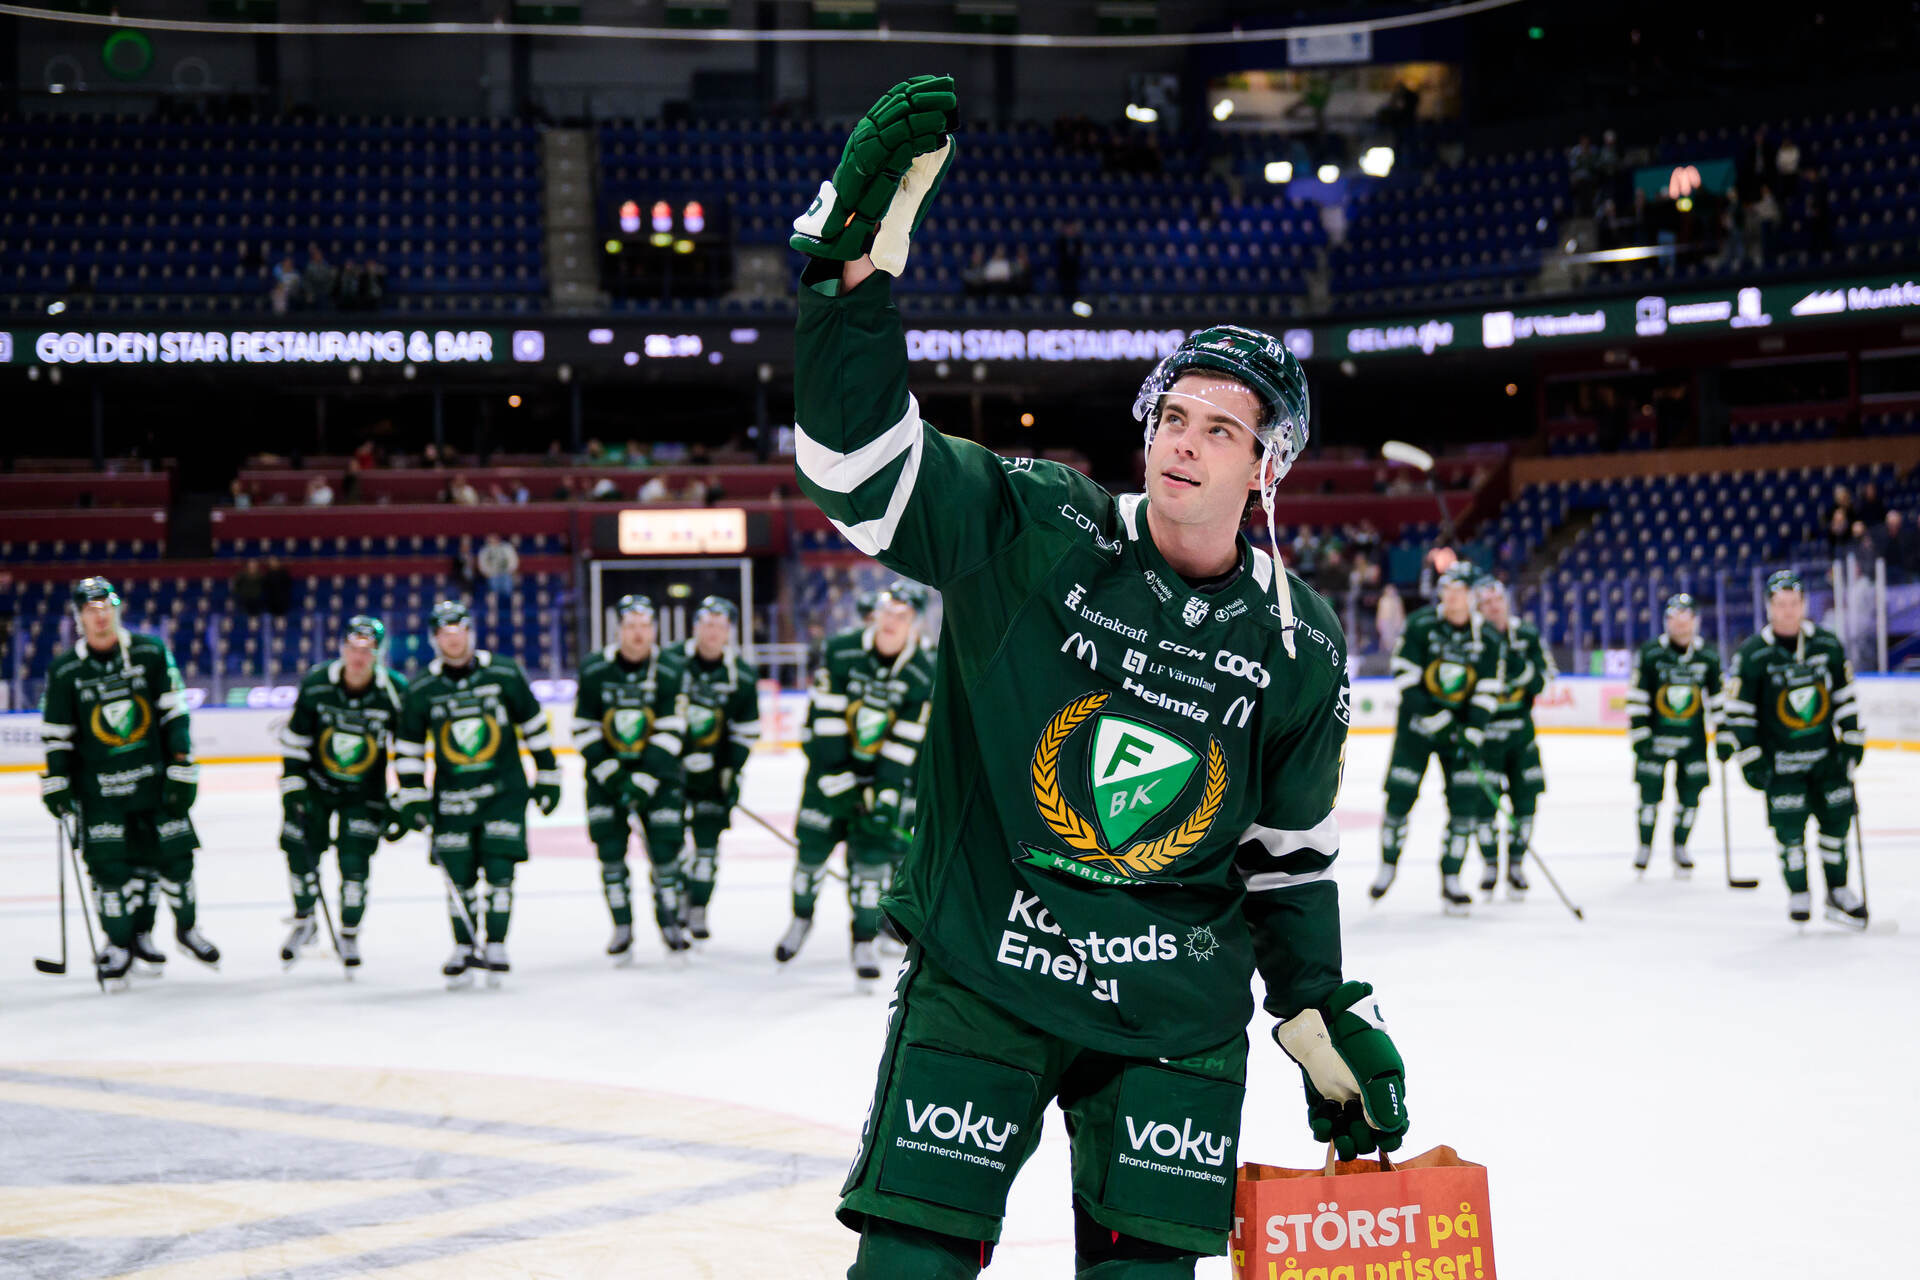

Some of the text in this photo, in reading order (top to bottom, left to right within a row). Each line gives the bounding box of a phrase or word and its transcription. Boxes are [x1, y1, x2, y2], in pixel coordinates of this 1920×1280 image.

[36, 331, 493, 364] GOLDEN STAR RESTAURANG & BAR
[963, 330, 1025, 360] STAR
[1080, 605, 1149, 643] Infrakraft
[1158, 640, 1207, 661] CCM
[1149, 663, 1165, 675] LF
[1122, 677, 1210, 724] Helmia
[1103, 732, 1155, 779] F
[1007, 889, 1178, 964] Kastads
[1388, 1083, 1399, 1116] CCM
[896, 1137, 1006, 1173] Brand merch made easy
[1119, 1153, 1227, 1186] Brand merch made easy
[1266, 1202, 1421, 1254] STÖRST
[1428, 1202, 1479, 1248] på
